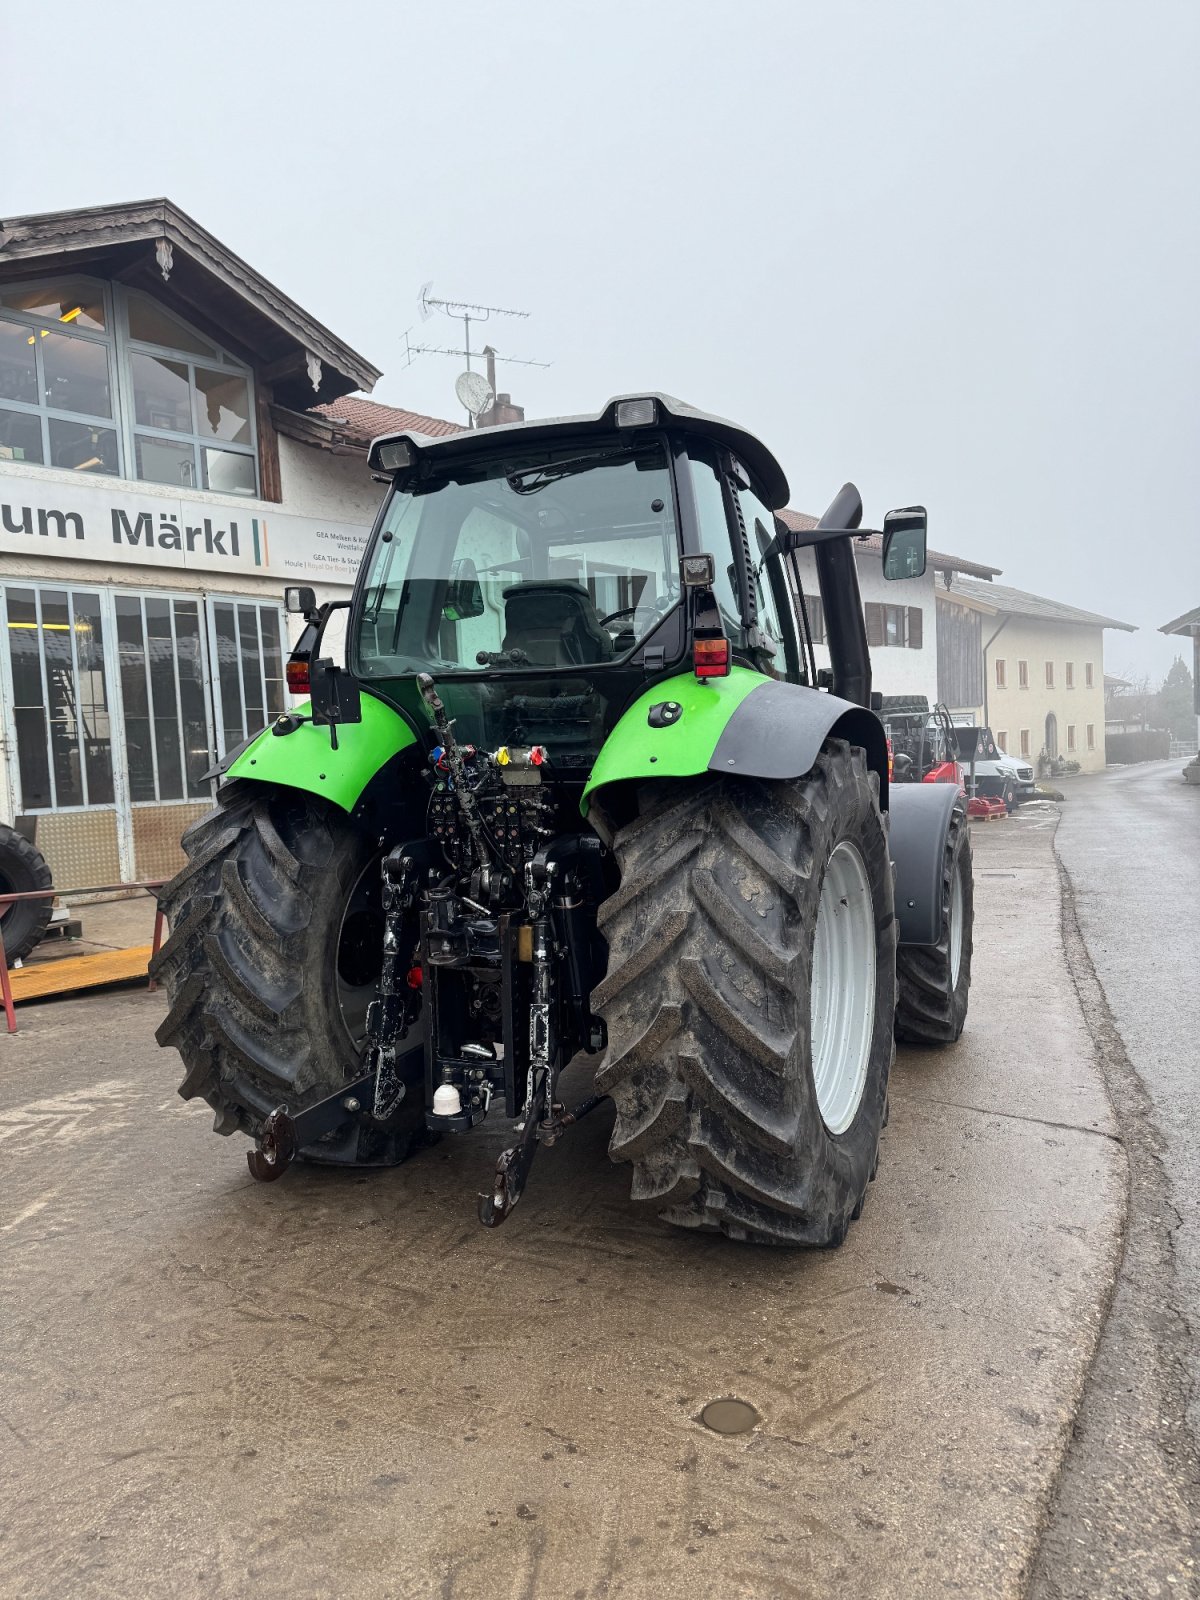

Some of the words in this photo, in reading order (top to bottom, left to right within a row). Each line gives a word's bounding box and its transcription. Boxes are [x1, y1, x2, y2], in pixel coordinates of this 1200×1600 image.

[111, 508, 240, 556] Märkl
[316, 531, 329, 539] GEA
[330, 533, 352, 542] Melken
[313, 554, 326, 562] GEA
[285, 560, 303, 568] Houle
